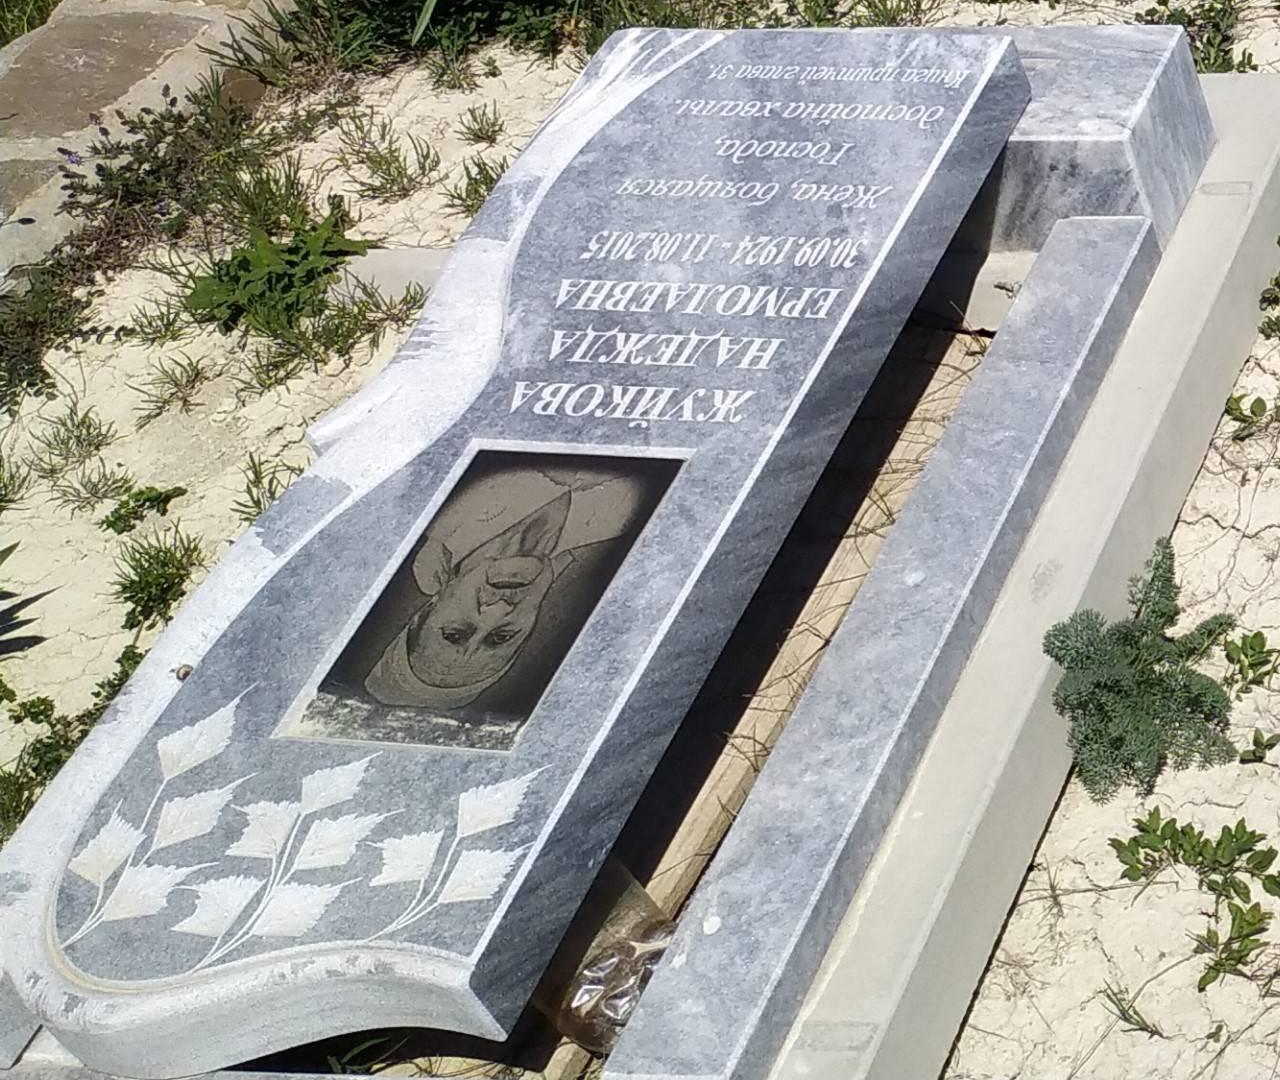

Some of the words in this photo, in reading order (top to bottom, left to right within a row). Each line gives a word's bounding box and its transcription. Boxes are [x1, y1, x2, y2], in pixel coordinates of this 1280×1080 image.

[735, 64, 801, 82] глава
[799, 64, 900, 86] притчей
[901, 68, 972, 89] Книга
[674, 98, 781, 119] хвалы.
[781, 100, 945, 130] достойна
[714, 135, 855, 165] Господа,
[615, 174, 780, 207] боящаяся
[790, 178, 893, 209] Жена,
[579, 230, 718, 264] 11.08.2015
[729, 235, 868, 269] 30.09.1924
[554, 277, 845, 320] ЕРМОЛАЕВНА
[549, 323, 786, 370] НАДЕЖДА
[509, 380, 757, 429] ЖУЙКОВА
